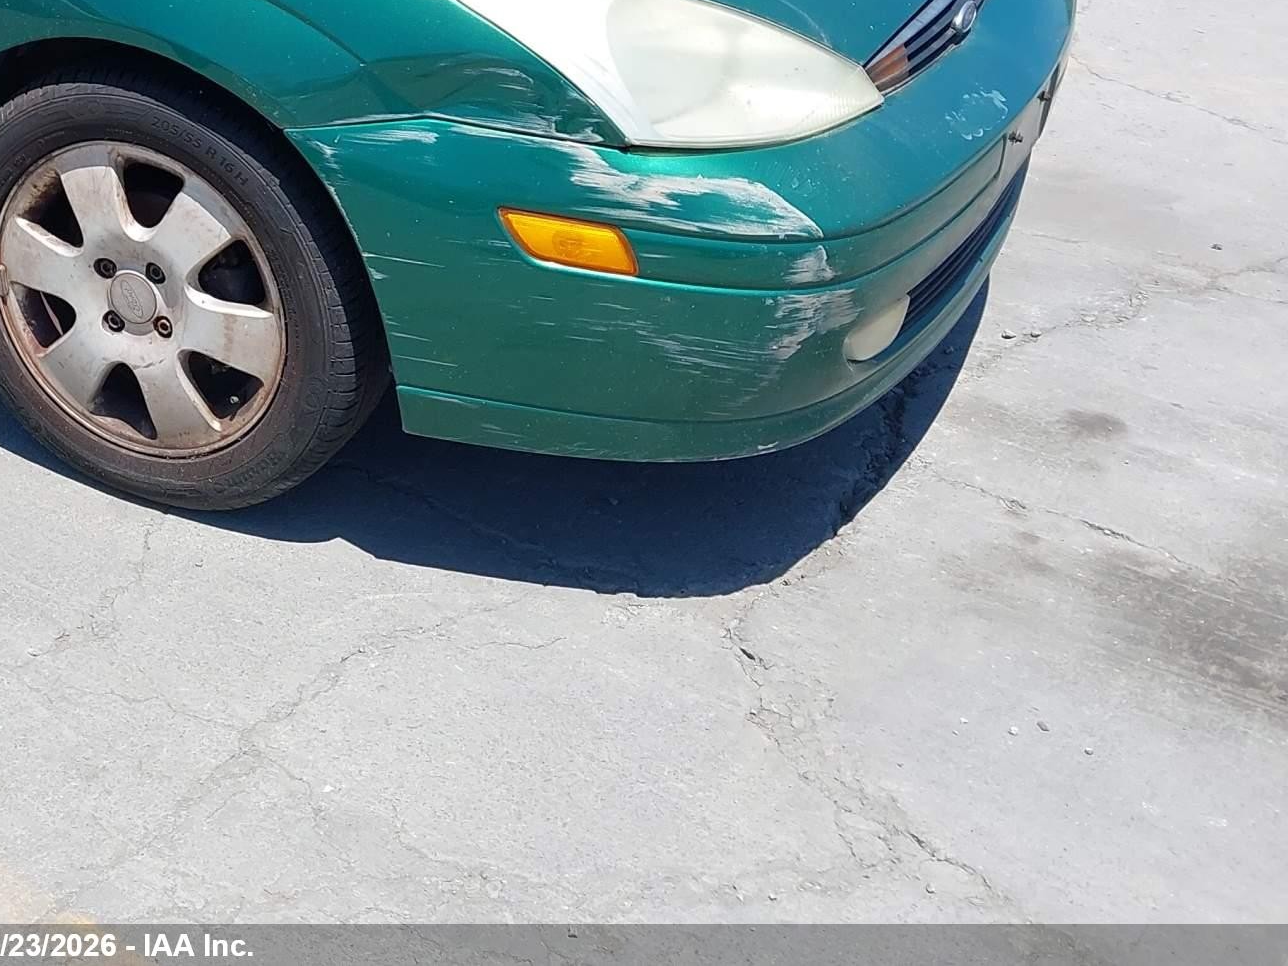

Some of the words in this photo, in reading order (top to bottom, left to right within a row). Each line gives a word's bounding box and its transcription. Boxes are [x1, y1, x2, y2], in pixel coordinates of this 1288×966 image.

[151, 116, 202, 149] 205/55
[206, 146, 217, 159] R
[217, 156, 235, 173] 16
